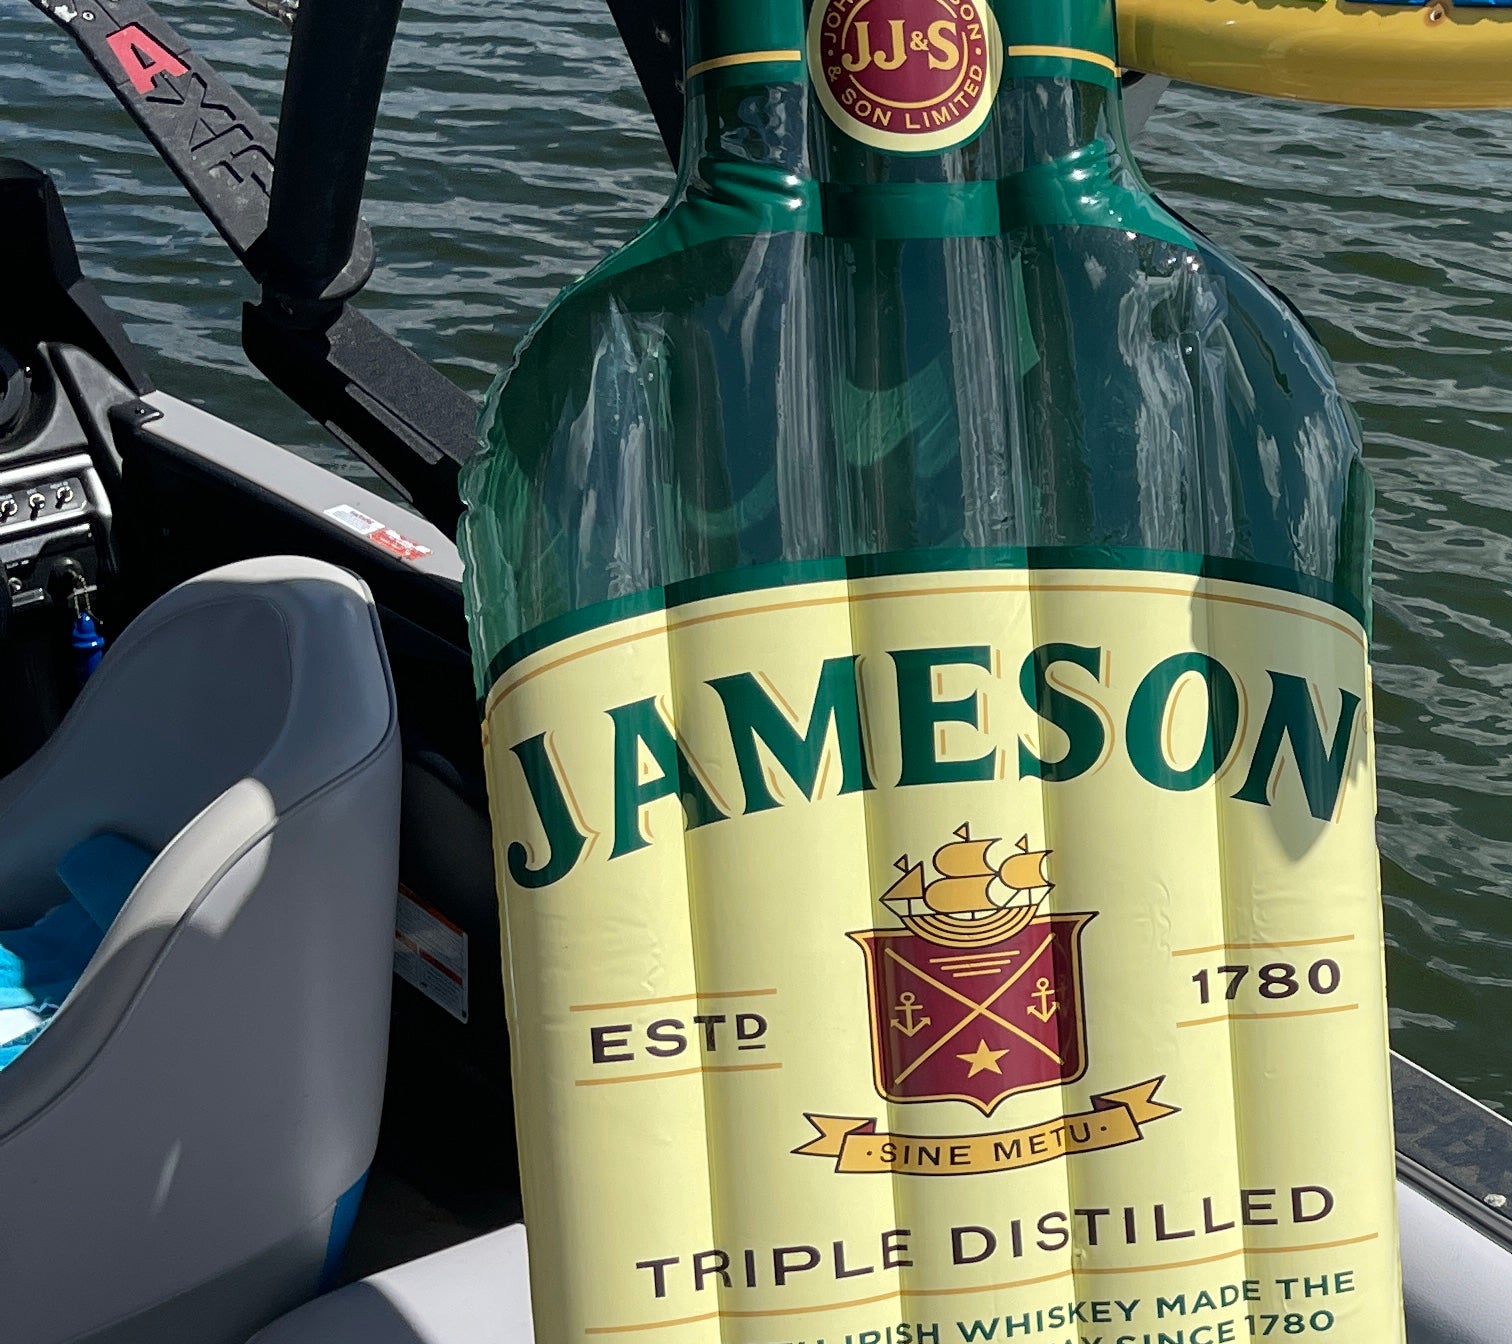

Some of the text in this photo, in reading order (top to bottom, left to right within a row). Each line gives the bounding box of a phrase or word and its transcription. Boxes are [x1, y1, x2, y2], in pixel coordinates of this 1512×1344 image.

[841, 19, 960, 73] JJ&S
[841, 87, 892, 127] SON
[905, 64, 983, 130] LIMITED
[506, 642, 1362, 889] JAMESON
[1191, 958, 1341, 1004] 1780
[590, 1013, 768, 1064] ESTD
[880, 1121, 1091, 1166] SINE METU
[635, 1184, 1335, 1299] TRIPLE DISTILLED
[956, 1298, 1141, 1342] WHISKEY
[1156, 1278, 1261, 1319] MADE
[1275, 1269, 1355, 1300] THE
[1244, 1309, 1334, 1337] 1780
